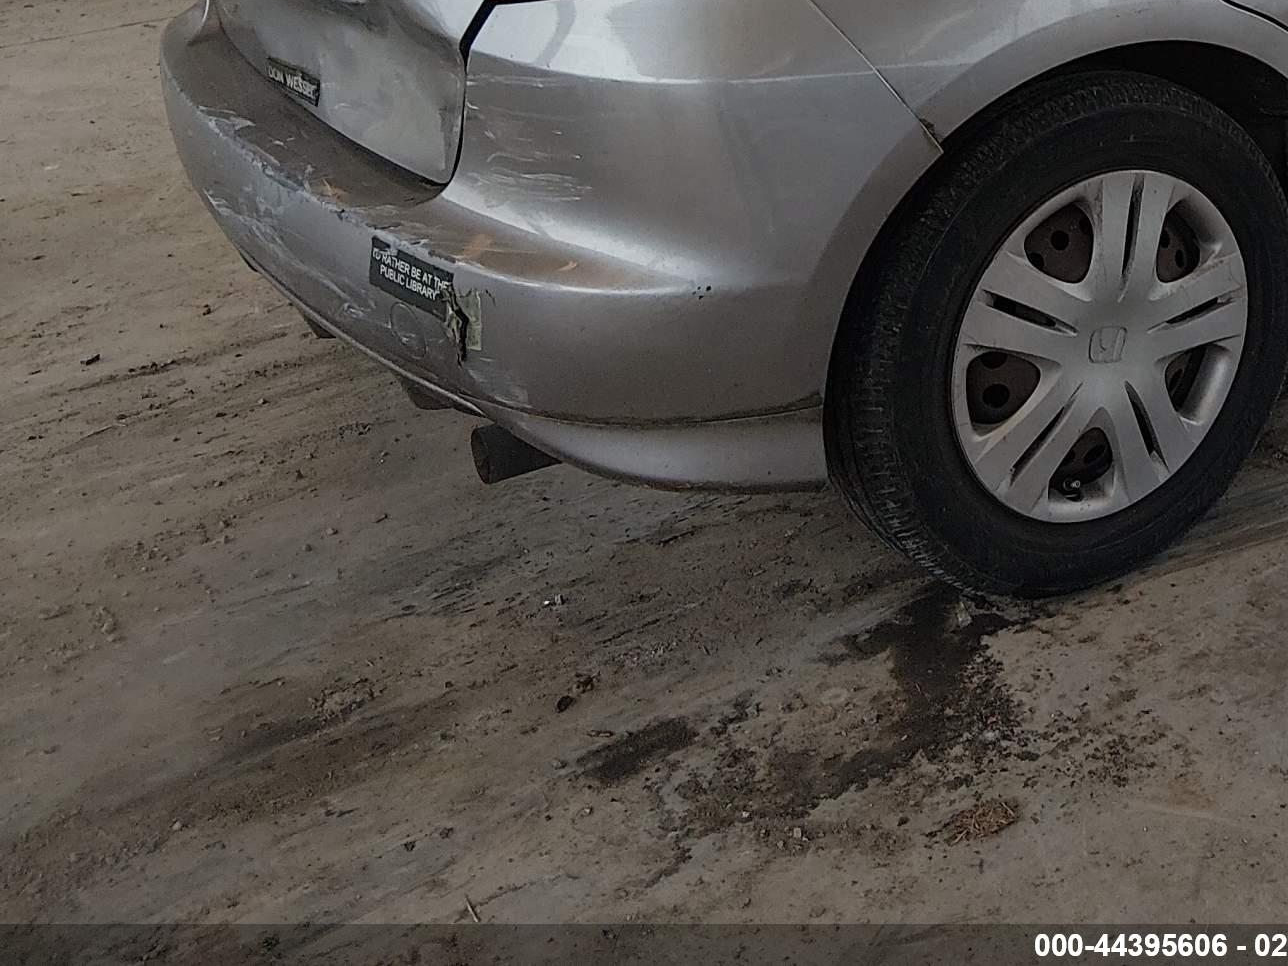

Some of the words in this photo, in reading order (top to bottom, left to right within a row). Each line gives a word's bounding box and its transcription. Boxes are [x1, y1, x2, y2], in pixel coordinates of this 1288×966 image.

[380, 264, 405, 286] PUBLIC
[405, 277, 440, 301] LIBRARY
[381, 251, 411, 275] RATHER
[411, 266, 422, 280] BE
[422, 273, 433, 286] AT
[433, 276, 450, 291] THE
